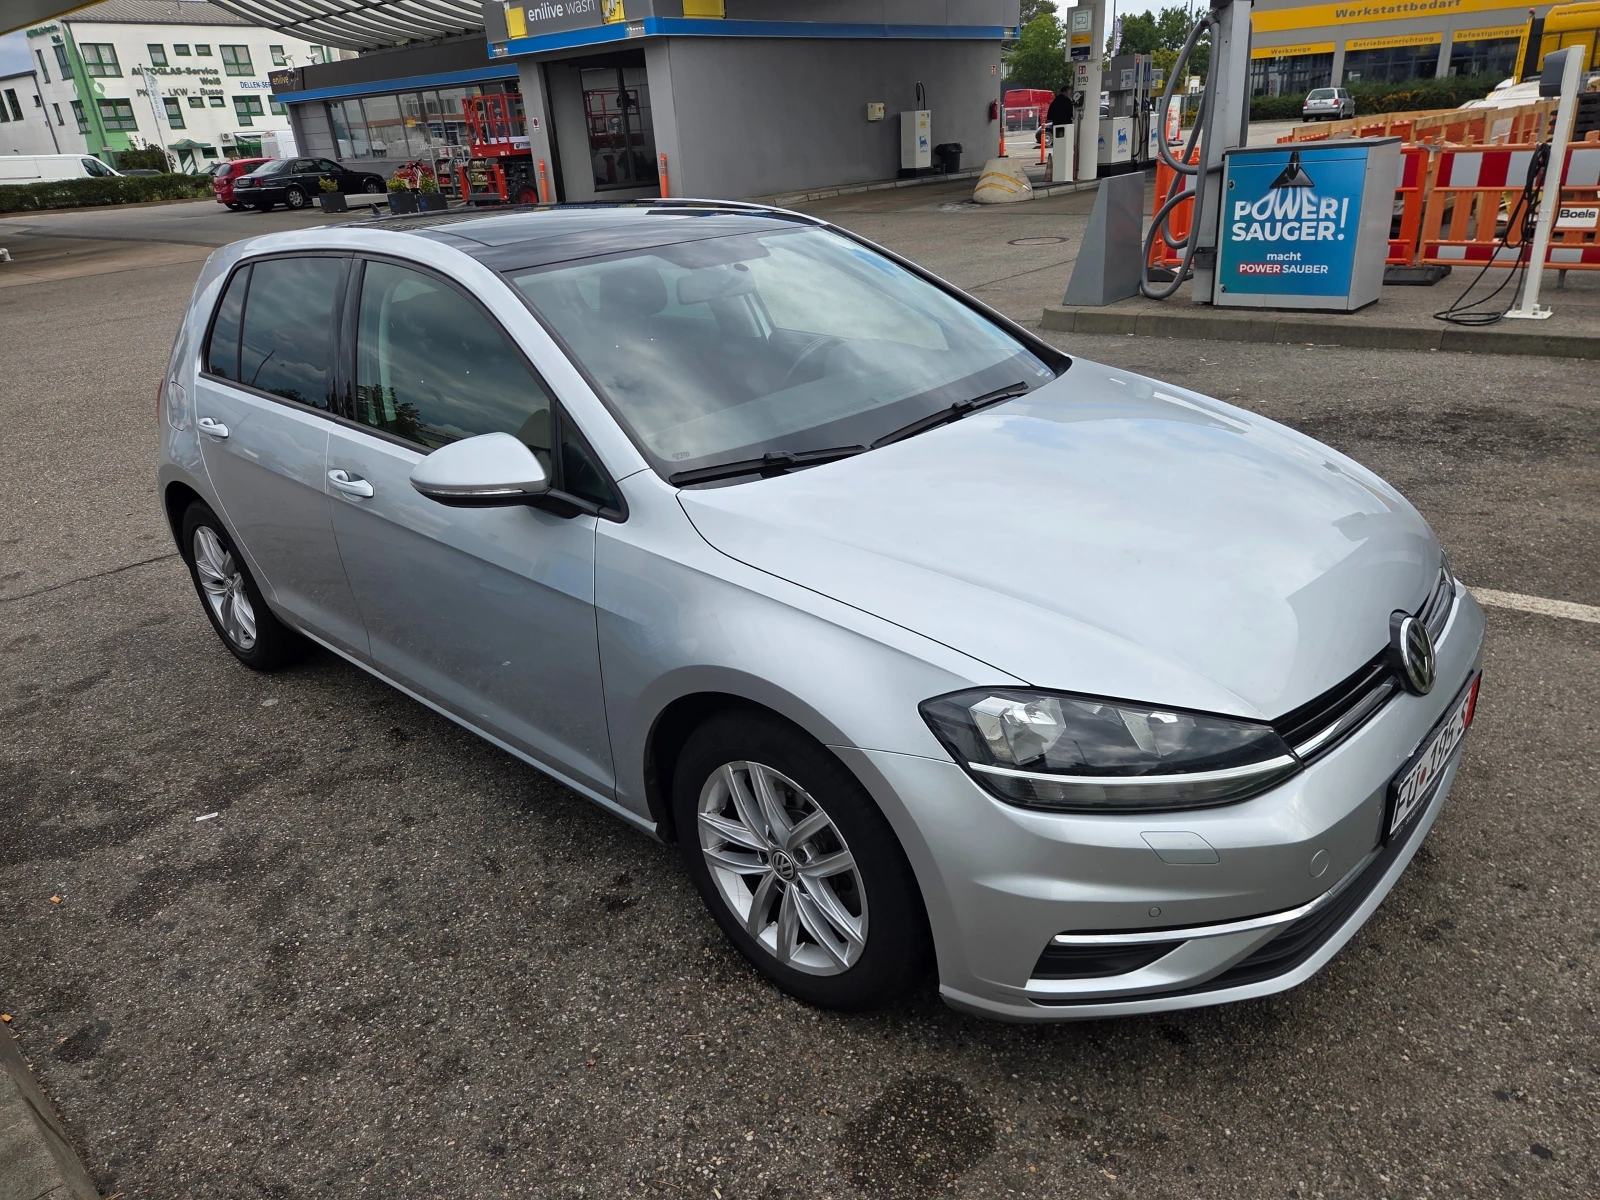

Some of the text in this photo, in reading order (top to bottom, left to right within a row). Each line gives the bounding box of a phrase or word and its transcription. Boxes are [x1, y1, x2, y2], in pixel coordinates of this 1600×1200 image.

[527, 0, 595, 21] enilive wash
[1335, 0, 1461, 18] Werkstattbedarf
[1353, 35, 1434, 48] Betriebseinrichtung
[1270, 46, 1312, 55] Werkzeuge
[199, 77, 222, 86] Weiß
[168, 88, 188, 96] LKW
[199, 88, 225, 96] Busse
[1560, 209, 1596, 219] Boels
[1266, 252, 1302, 261] macht
[1239, 264, 1329, 274] POWER SAUBER
